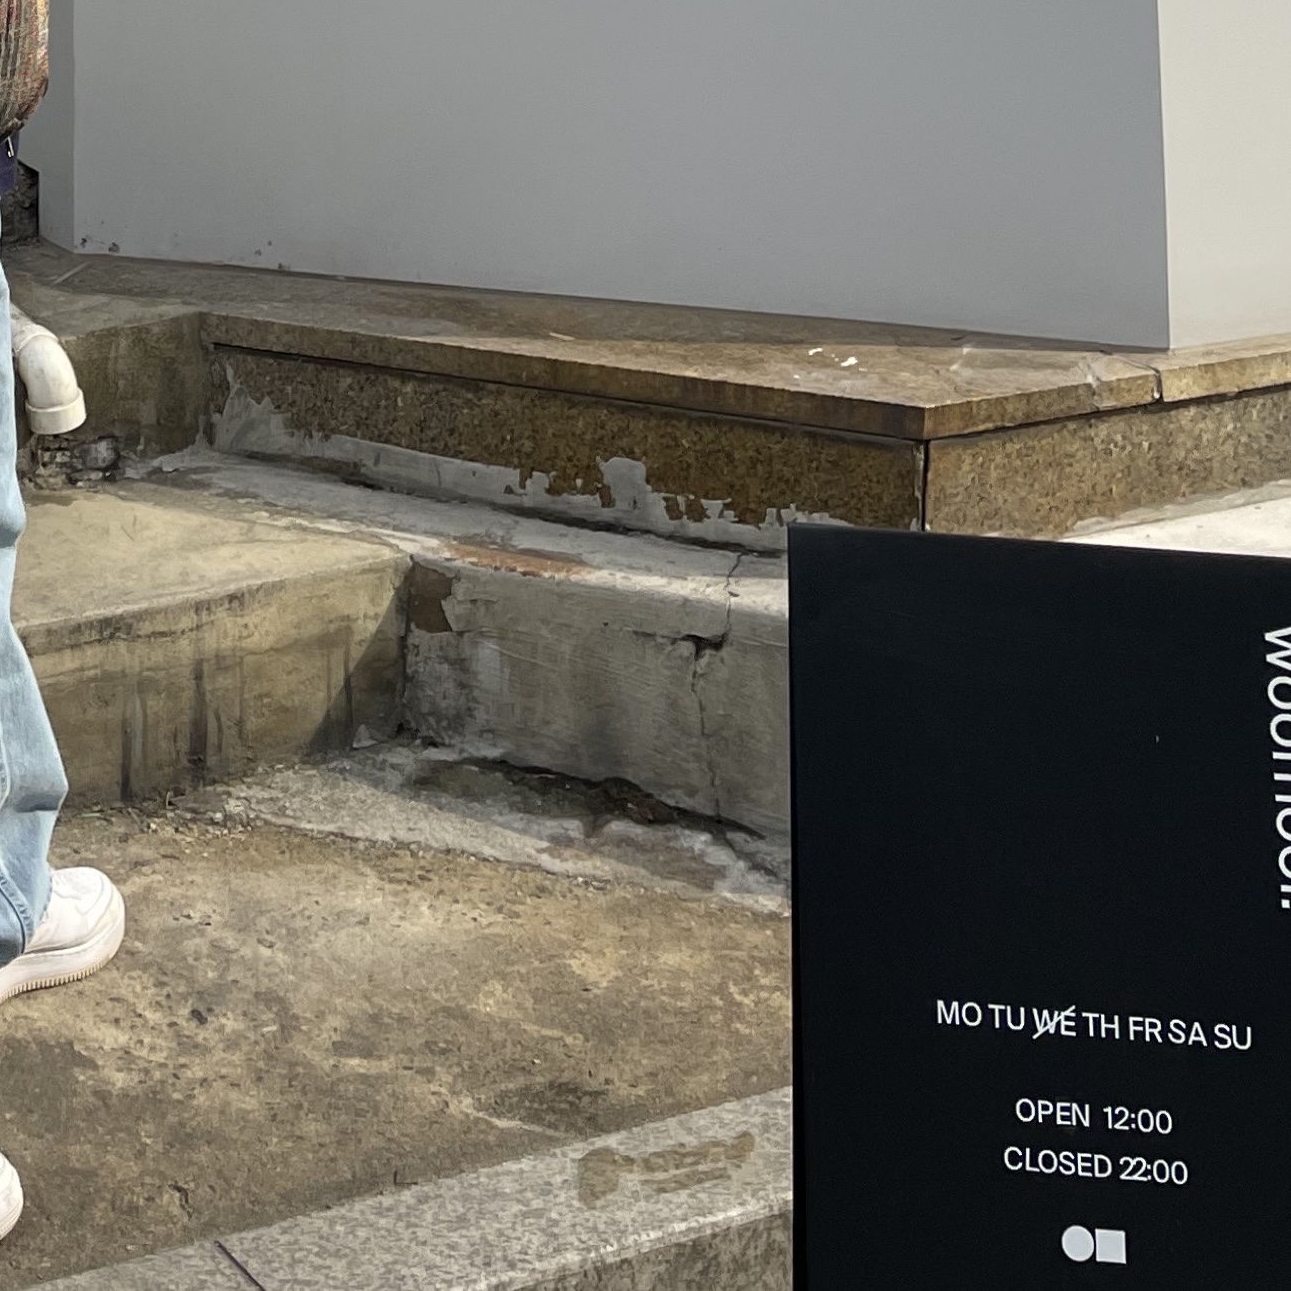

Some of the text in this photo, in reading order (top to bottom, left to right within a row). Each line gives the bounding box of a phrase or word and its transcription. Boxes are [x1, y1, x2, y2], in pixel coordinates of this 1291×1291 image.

[937, 999, 982, 1026] MO
[987, 1003, 1025, 1031] TU
[1081, 1012, 1120, 1040] TH
[1128, 1016, 1163, 1043] FR
[1167, 1019, 1208, 1047] SA
[1214, 1024, 1252, 1050] SU
[1015, 1098, 1173, 1134] OPEN 12:00
[1003, 1146, 1188, 1185] CLOSED 22:00
